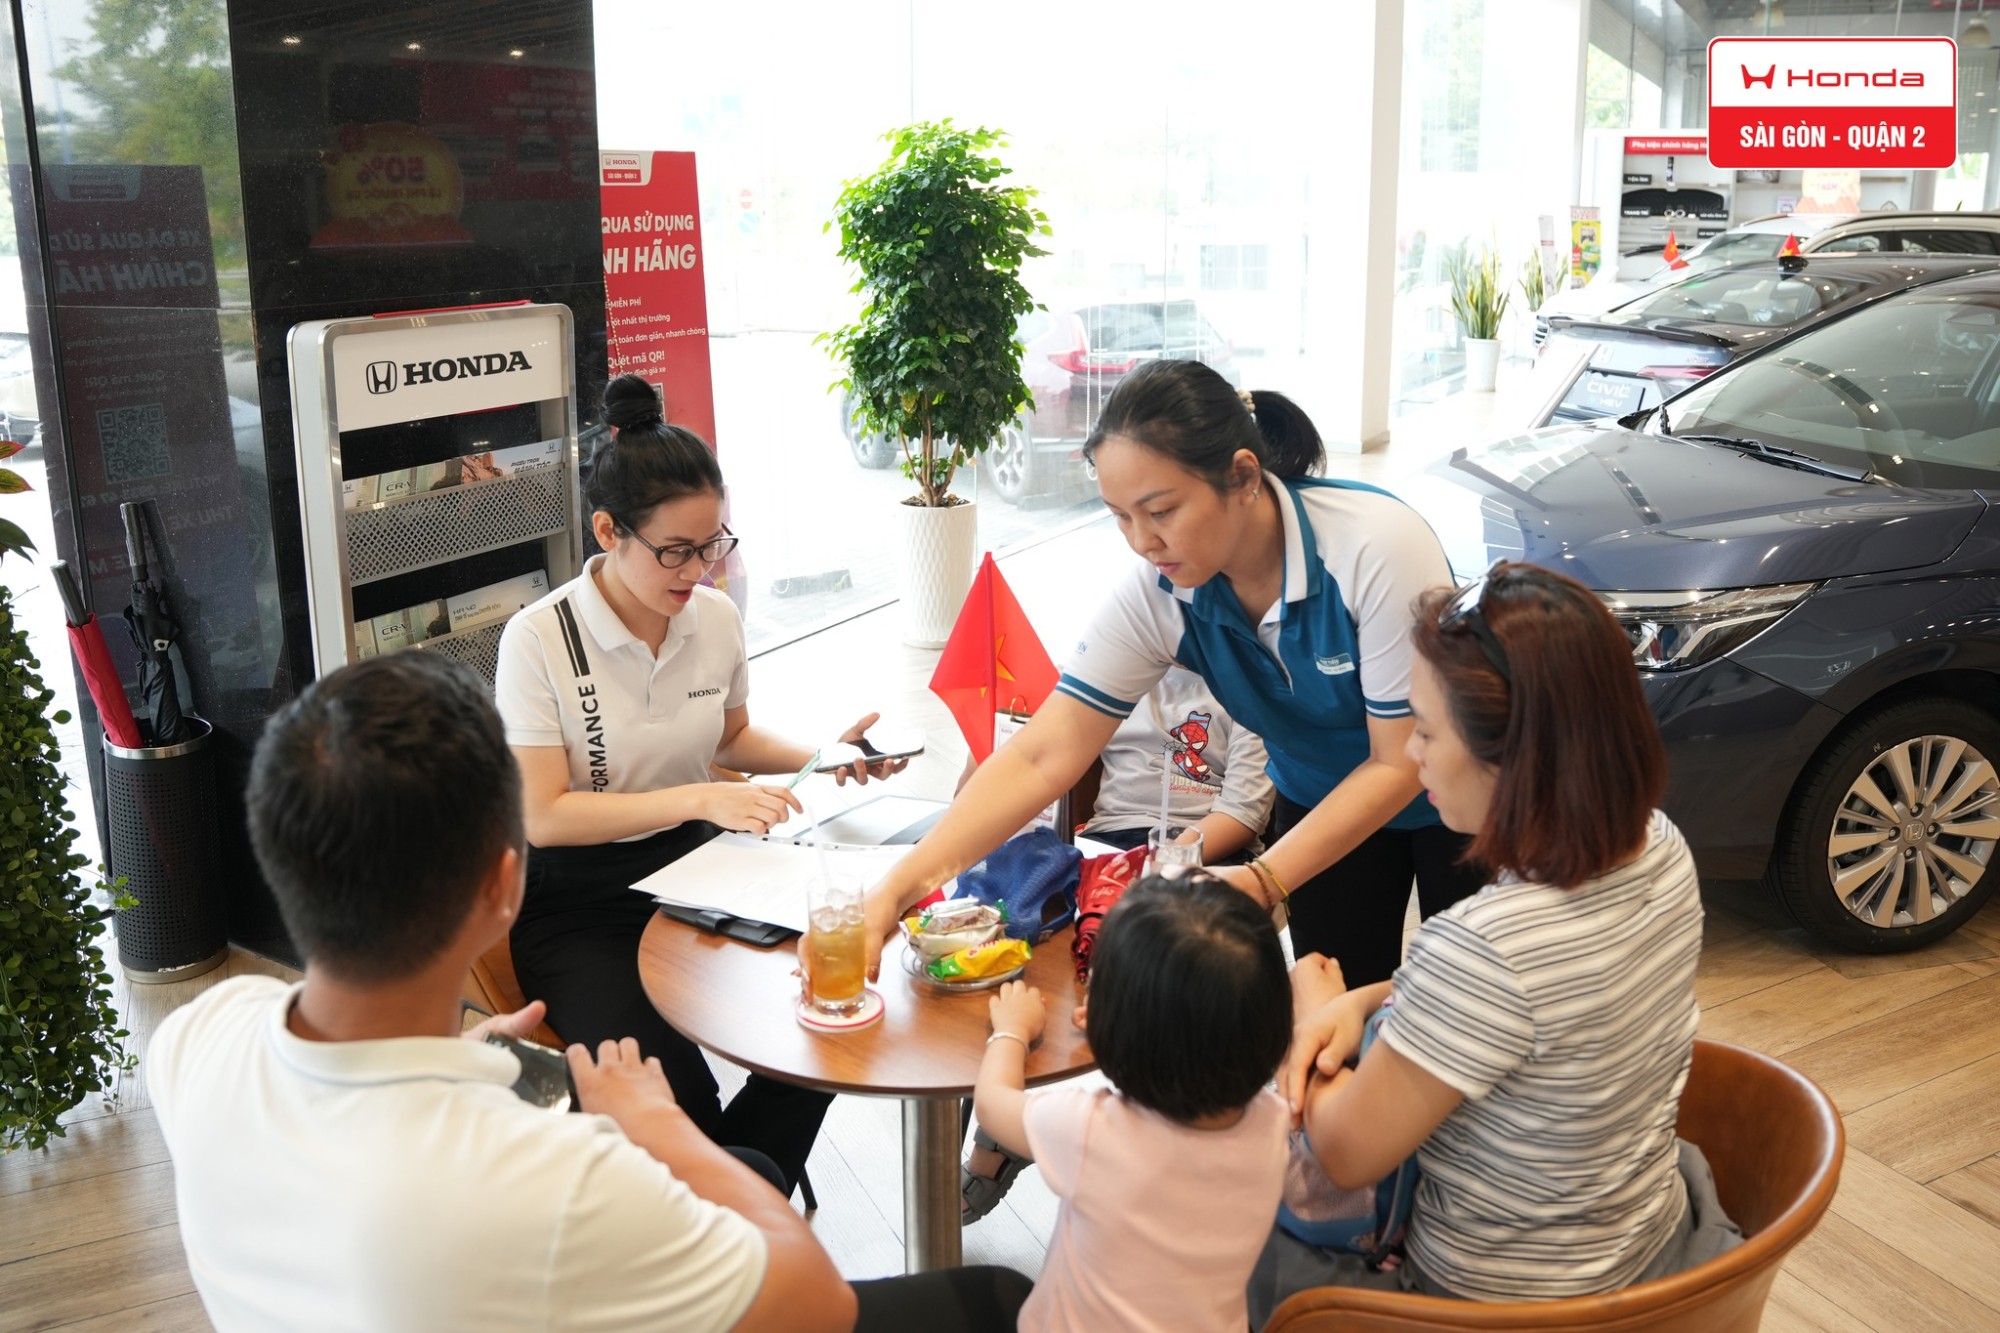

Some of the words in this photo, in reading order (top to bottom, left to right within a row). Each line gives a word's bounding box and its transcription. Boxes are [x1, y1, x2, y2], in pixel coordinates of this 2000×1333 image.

[601, 216, 632, 234] QUA
[634, 210, 654, 233] SỬ
[654, 214, 694, 237] DỤNG
[603, 247, 629, 274] NH
[634, 238, 696, 273] HÃNG
[629, 295, 642, 307] PHÍ
[621, 315, 638, 326] nhất
[648, 313, 671, 324] trường
[618, 335, 634, 344] toán
[635, 333, 648, 343] đơn
[665, 328, 686, 339] nhanh
[686, 327, 706, 336] chóng
[632, 352, 647, 364] mã
[648, 350, 665, 363] QR!
[402, 350, 532, 386] HONDA
[1586, 380, 1631, 399] CIVIC
[381, 623, 409, 636] CR-V
[687, 687, 721, 699] HONDA
[578, 683, 609, 793] FORMANCE
